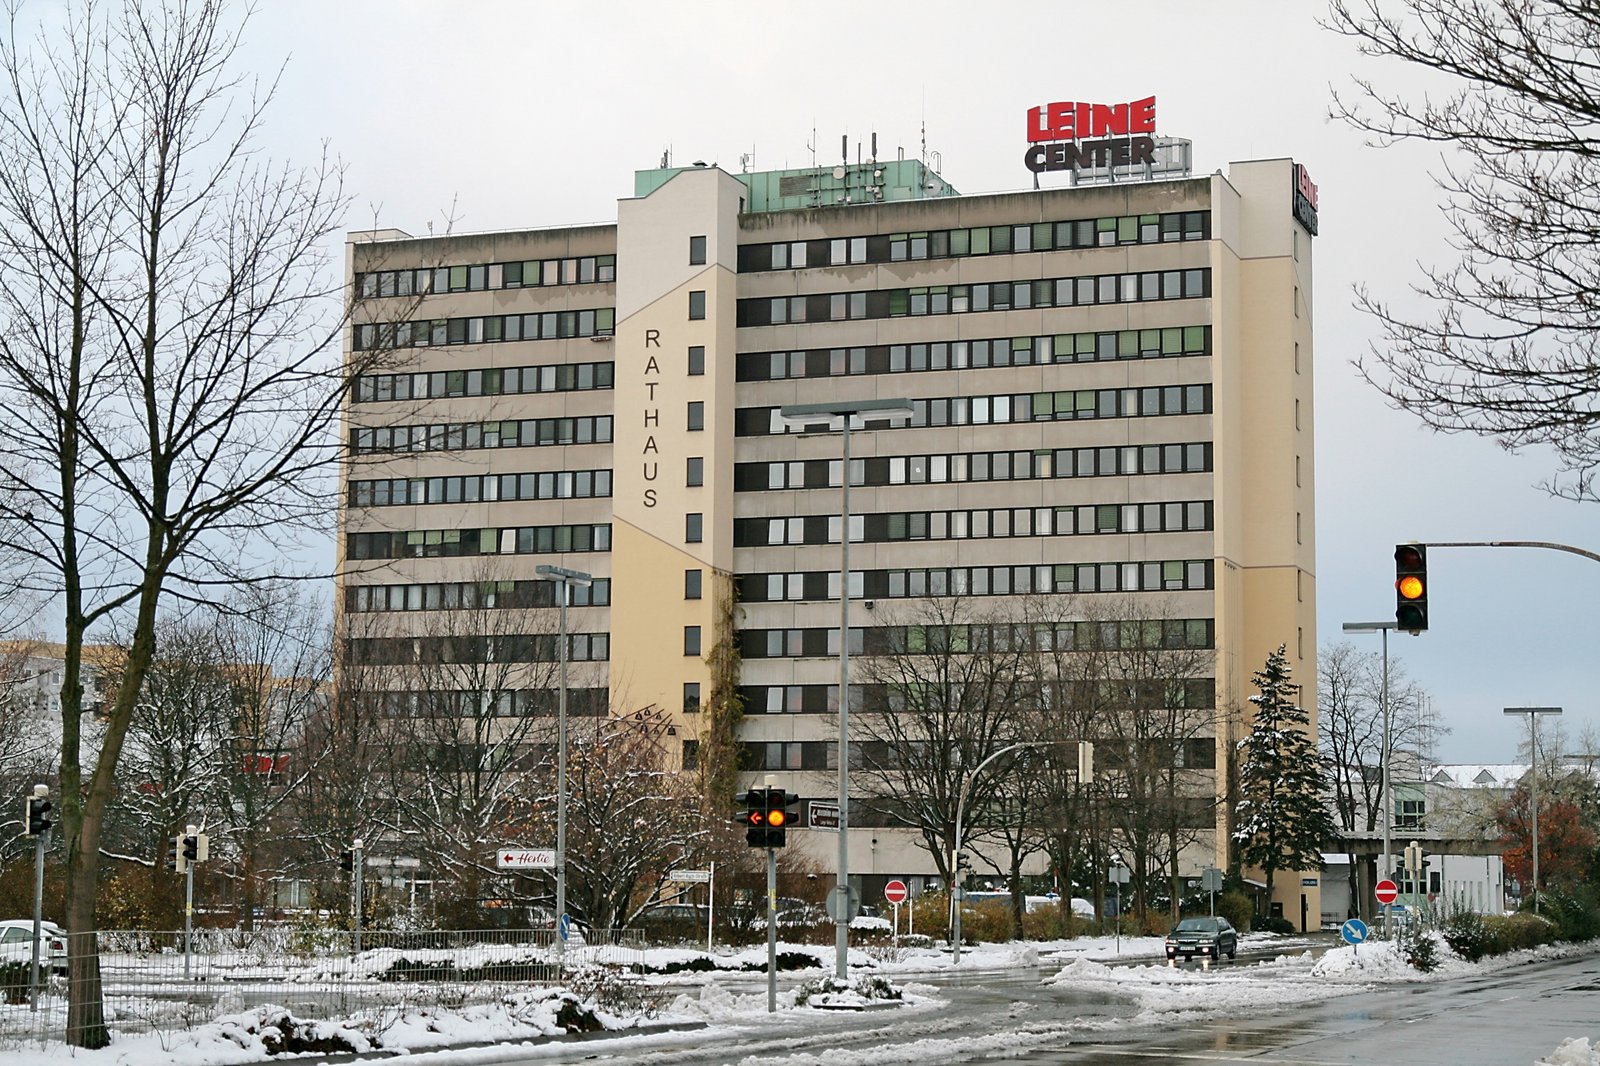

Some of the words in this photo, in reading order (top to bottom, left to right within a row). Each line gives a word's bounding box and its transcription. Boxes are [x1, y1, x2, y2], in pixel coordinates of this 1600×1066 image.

[1027, 95, 1156, 142] LEINE
[1024, 136, 1157, 173] CENTER
[643, 329, 661, 508] RATHAUS
